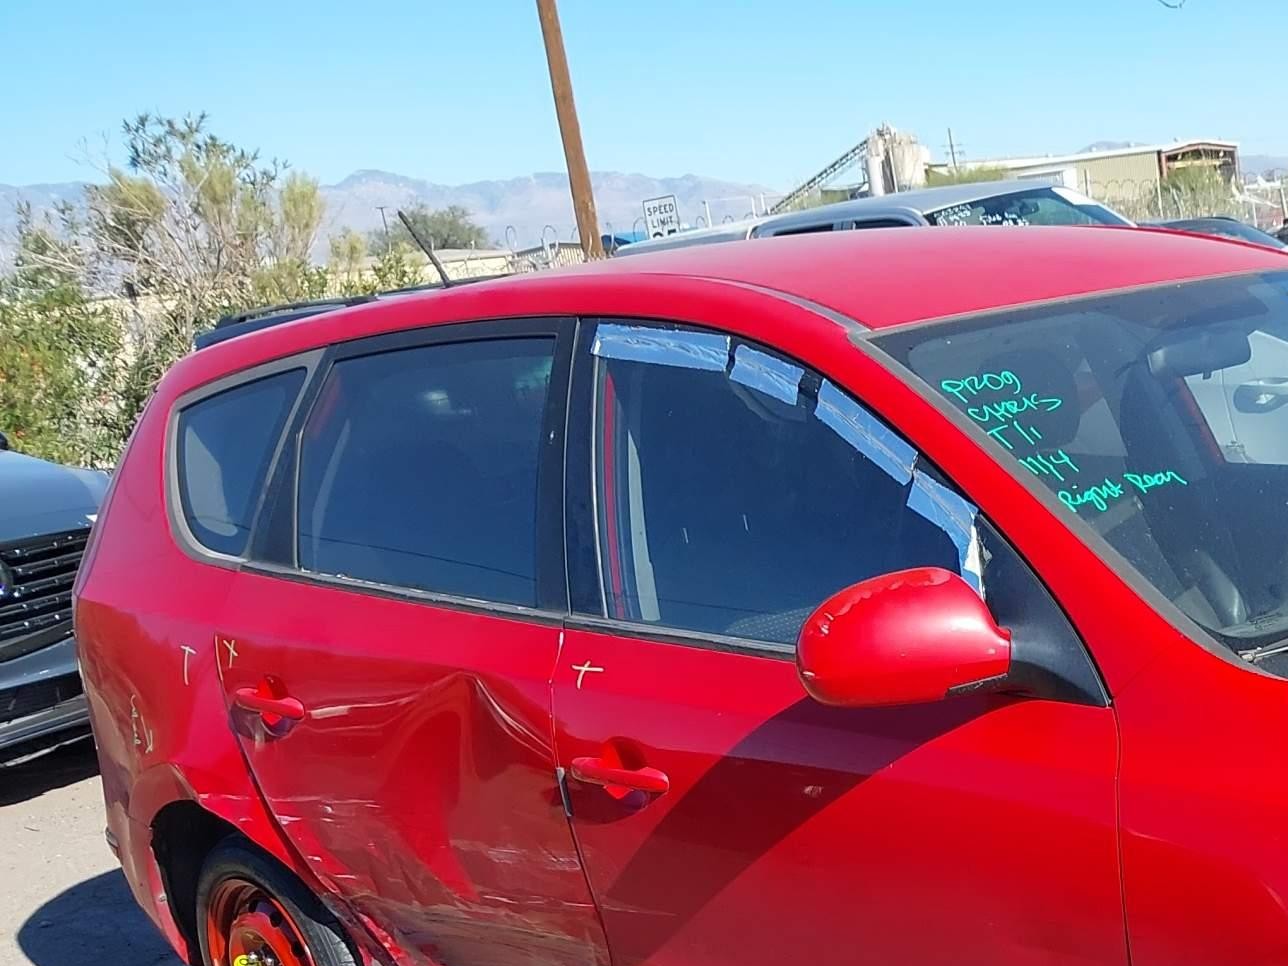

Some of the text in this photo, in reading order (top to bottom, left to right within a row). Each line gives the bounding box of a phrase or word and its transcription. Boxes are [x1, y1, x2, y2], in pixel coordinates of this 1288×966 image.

[647, 203, 674, 217] SPEED
[651, 215, 673, 228] LIMIT
[1057, 478, 1124, 513] Right
